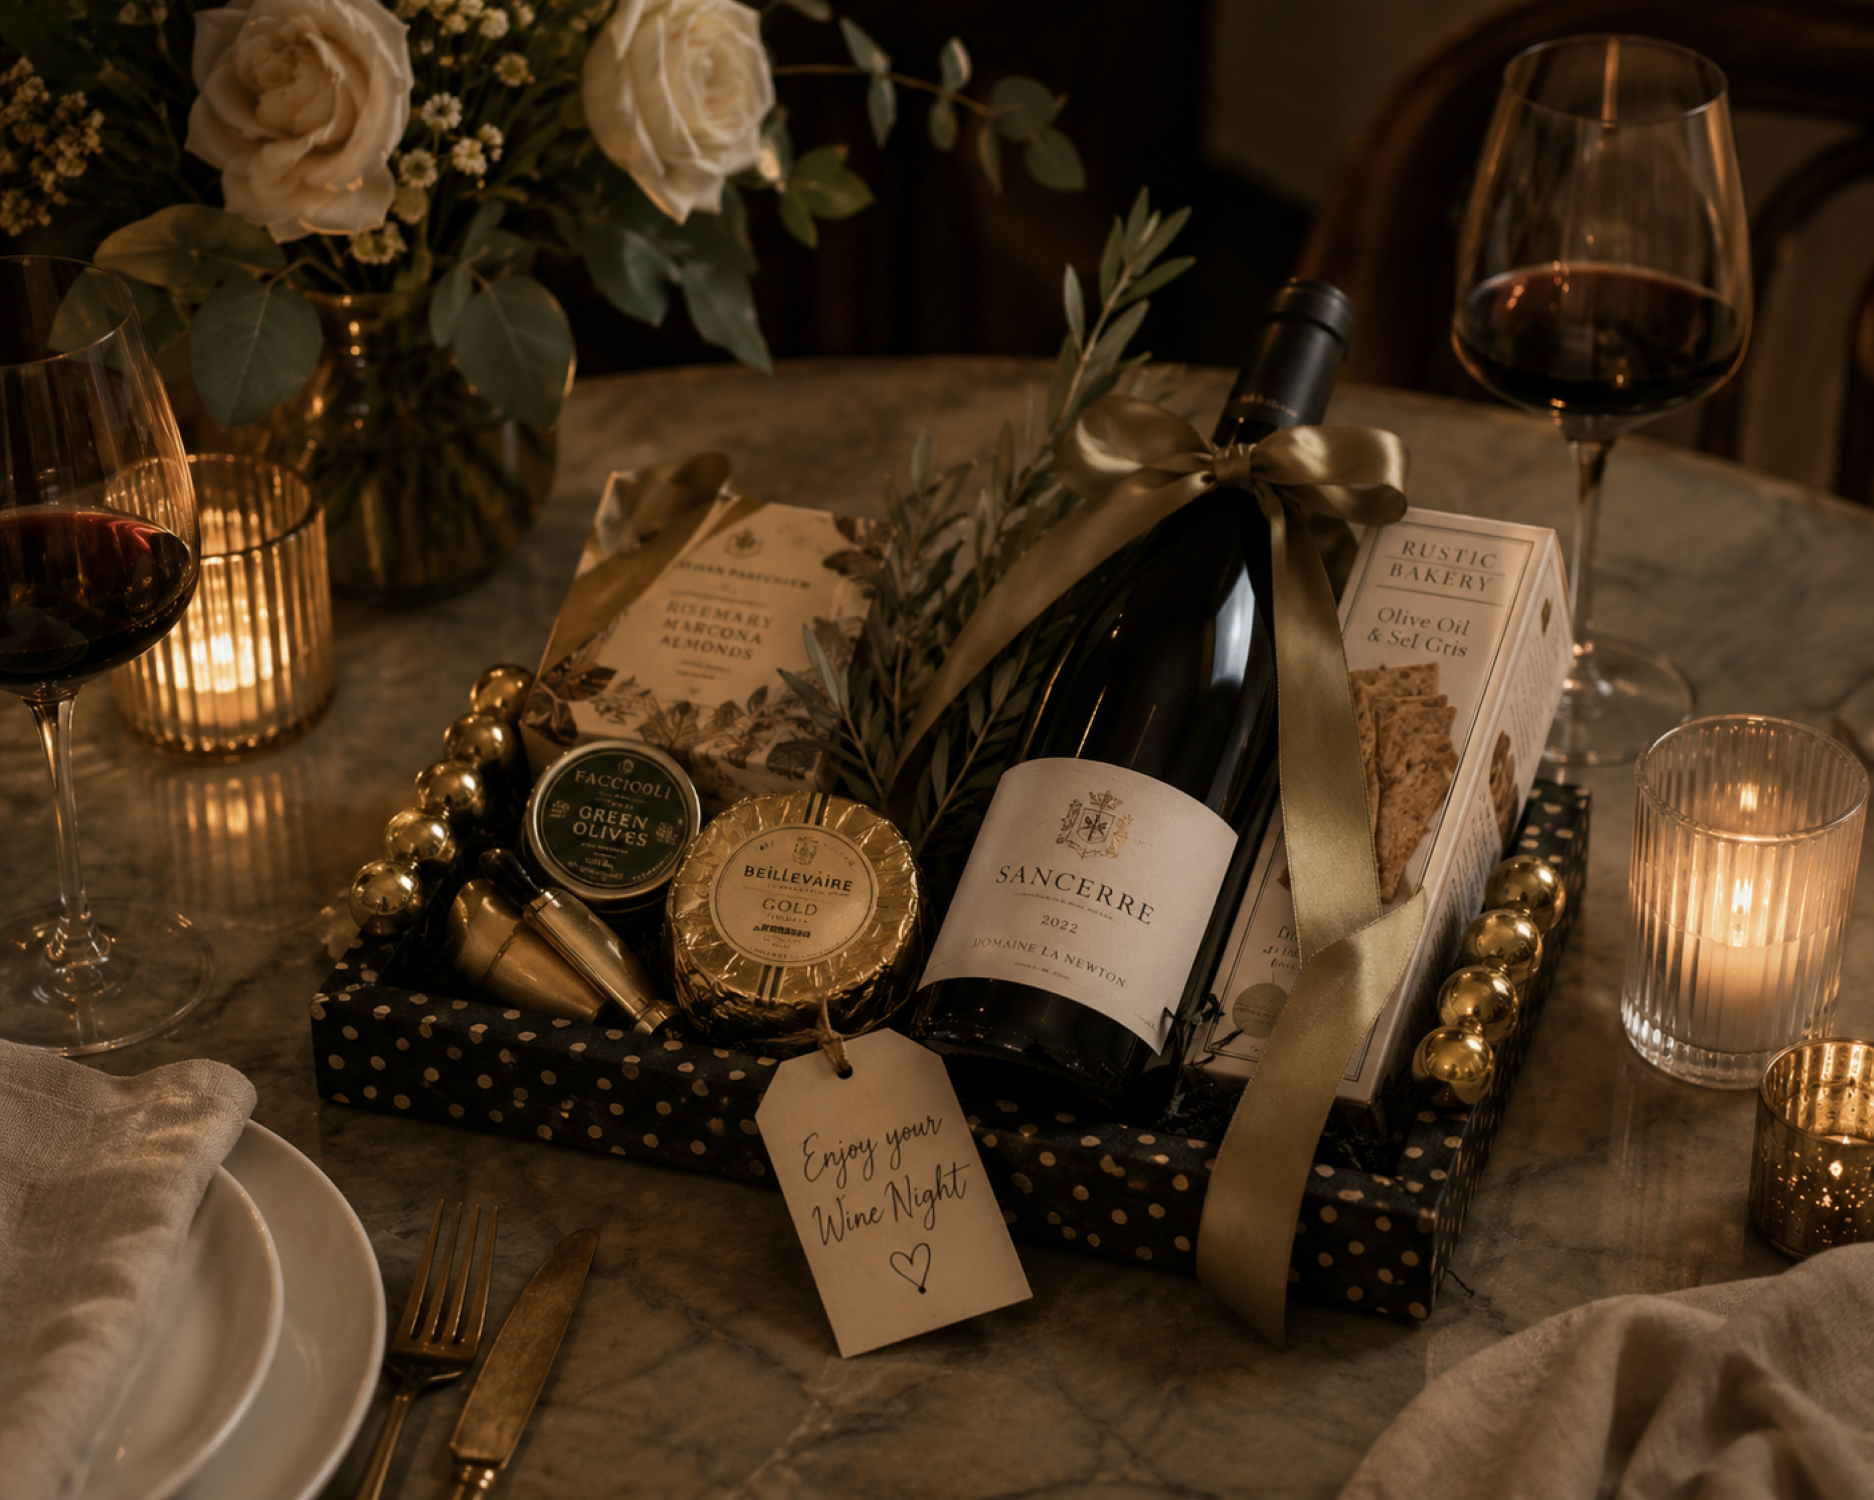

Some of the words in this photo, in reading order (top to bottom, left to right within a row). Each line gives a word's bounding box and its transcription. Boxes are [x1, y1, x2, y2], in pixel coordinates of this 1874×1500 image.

[1401, 540, 1498, 568] RUSTIC
[1389, 562, 1494, 591] BAKERY
[666, 600, 775, 629] ROSEMARY
[1377, 607, 1431, 630] Olive
[1437, 616, 1471, 636] Oil
[662, 618, 762, 644] MARCONA
[1367, 627, 1381, 642] &
[1387, 629, 1418, 649] Sel
[1425, 636, 1468, 657] Gris
[659, 635, 753, 660] ALMONDS
[578, 805, 649, 830] GREEN
[572, 821, 649, 847] OLIVES
[762, 897, 818, 917] GOLD
[995, 865, 1155, 926] SANCERRE
[1040, 914, 1079, 934] 2022
[972, 937, 1037, 954] DOMAINE
[1040, 945, 1059, 960] LA
[1064, 953, 1126, 989] NEWTON
[802, 1132, 878, 1189] Enjoy
[885, 1115, 943, 1171] your
[811, 1194, 885, 1246] Wine
[884, 1162, 970, 1232] Night
